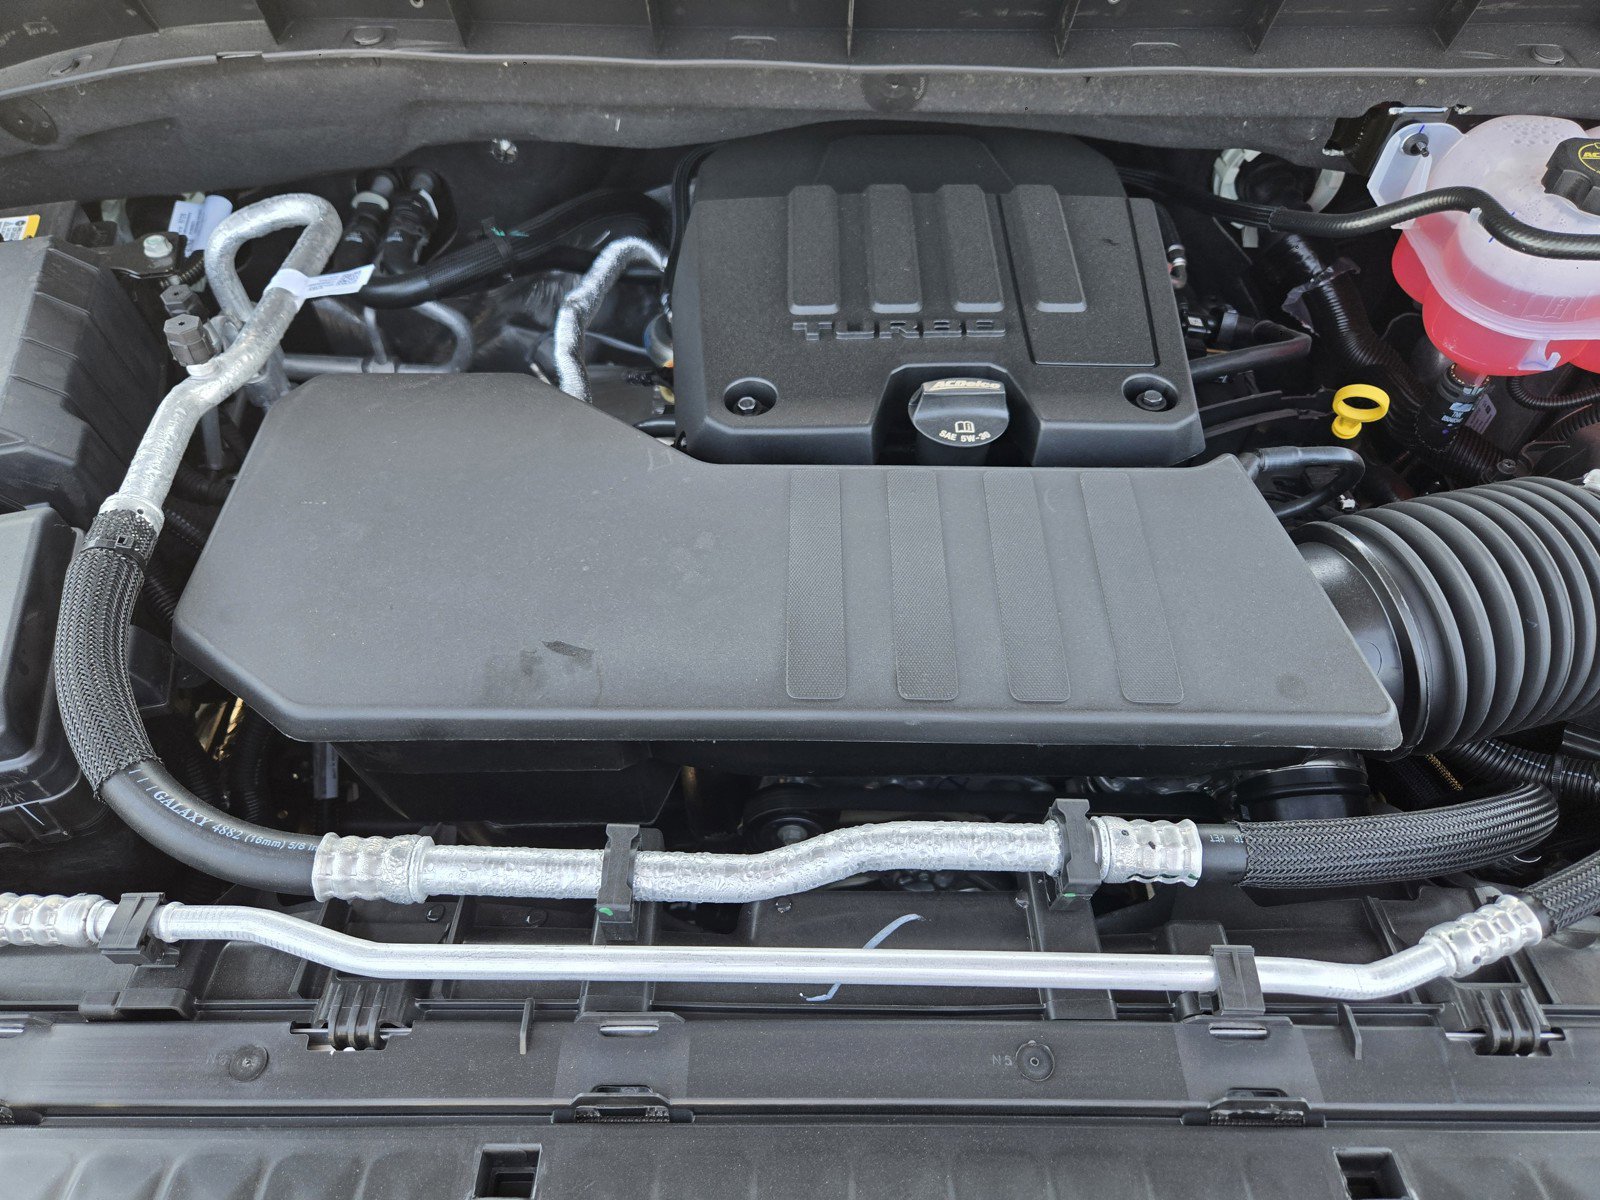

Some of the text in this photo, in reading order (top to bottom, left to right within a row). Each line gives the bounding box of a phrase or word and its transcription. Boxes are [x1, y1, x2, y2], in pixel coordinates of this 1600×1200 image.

[792, 319, 1006, 341] TURBO
[929, 380, 1001, 392] ACDelco
[939, 429, 991, 443] SAE 5W-30
[153, 790, 214, 827] GALAXY
[212, 823, 243, 840] 4882
[244, 833, 286, 850] (16mm)
